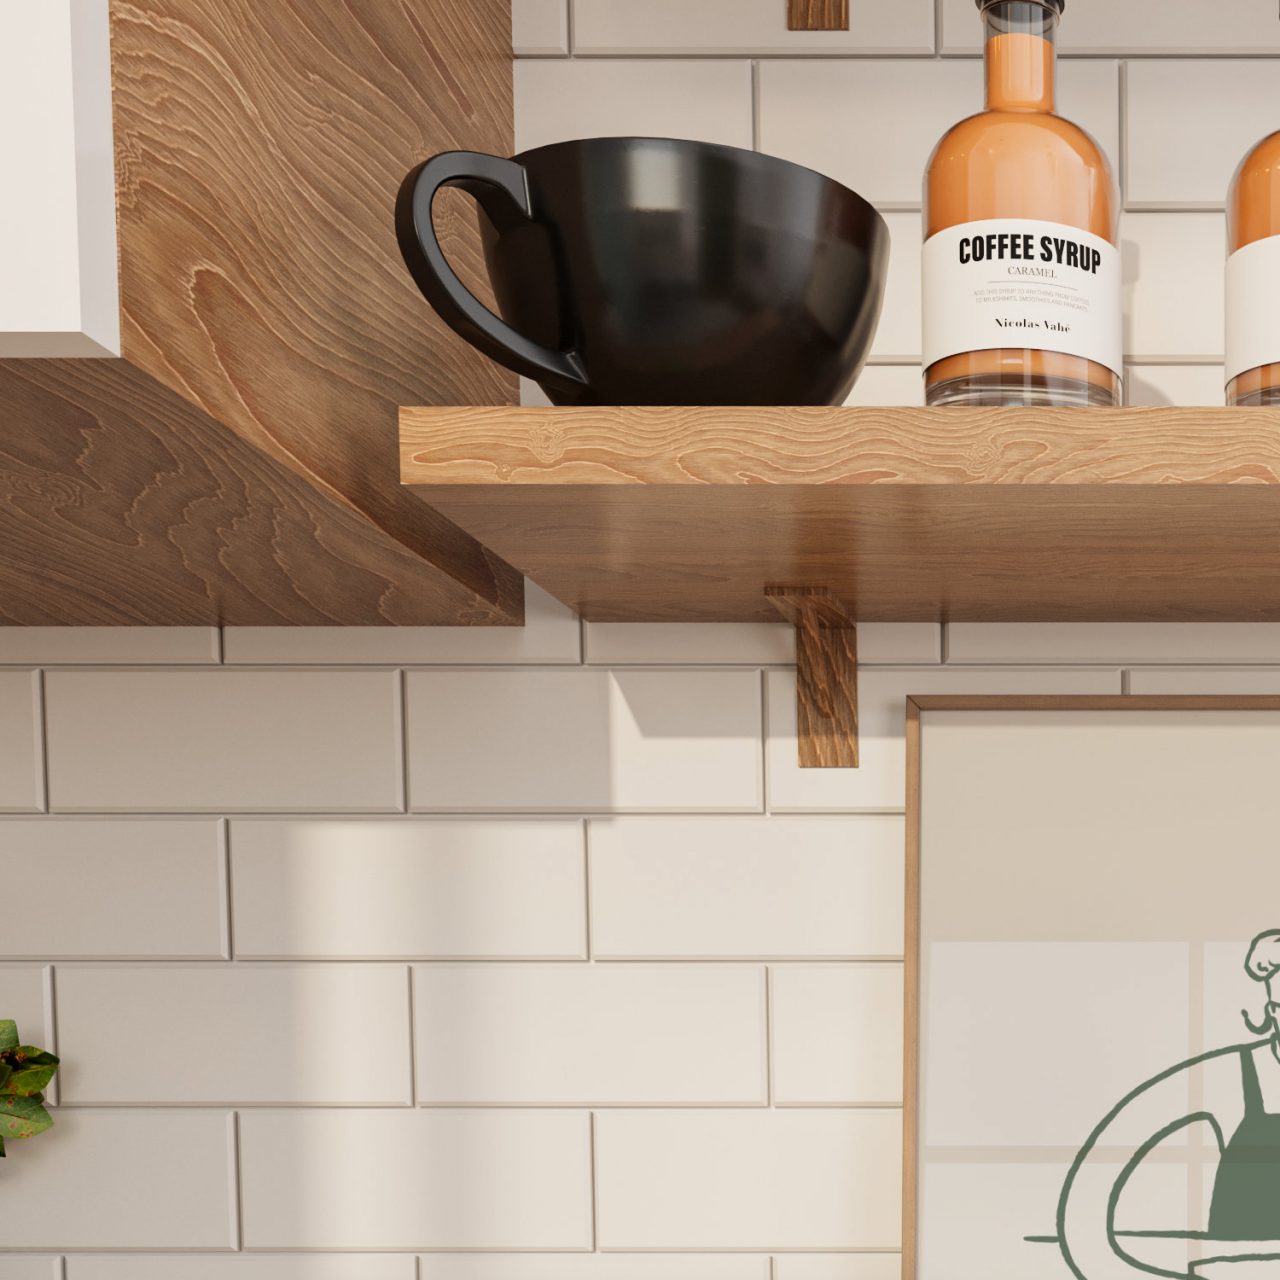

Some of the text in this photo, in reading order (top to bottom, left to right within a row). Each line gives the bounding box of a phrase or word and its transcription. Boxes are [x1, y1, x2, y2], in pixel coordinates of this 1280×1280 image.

[960, 234, 1101, 275] COFFEE SYRUP
[1008, 266, 1057, 279] CARAMEL
[995, 318, 1039, 329] Nicolas
